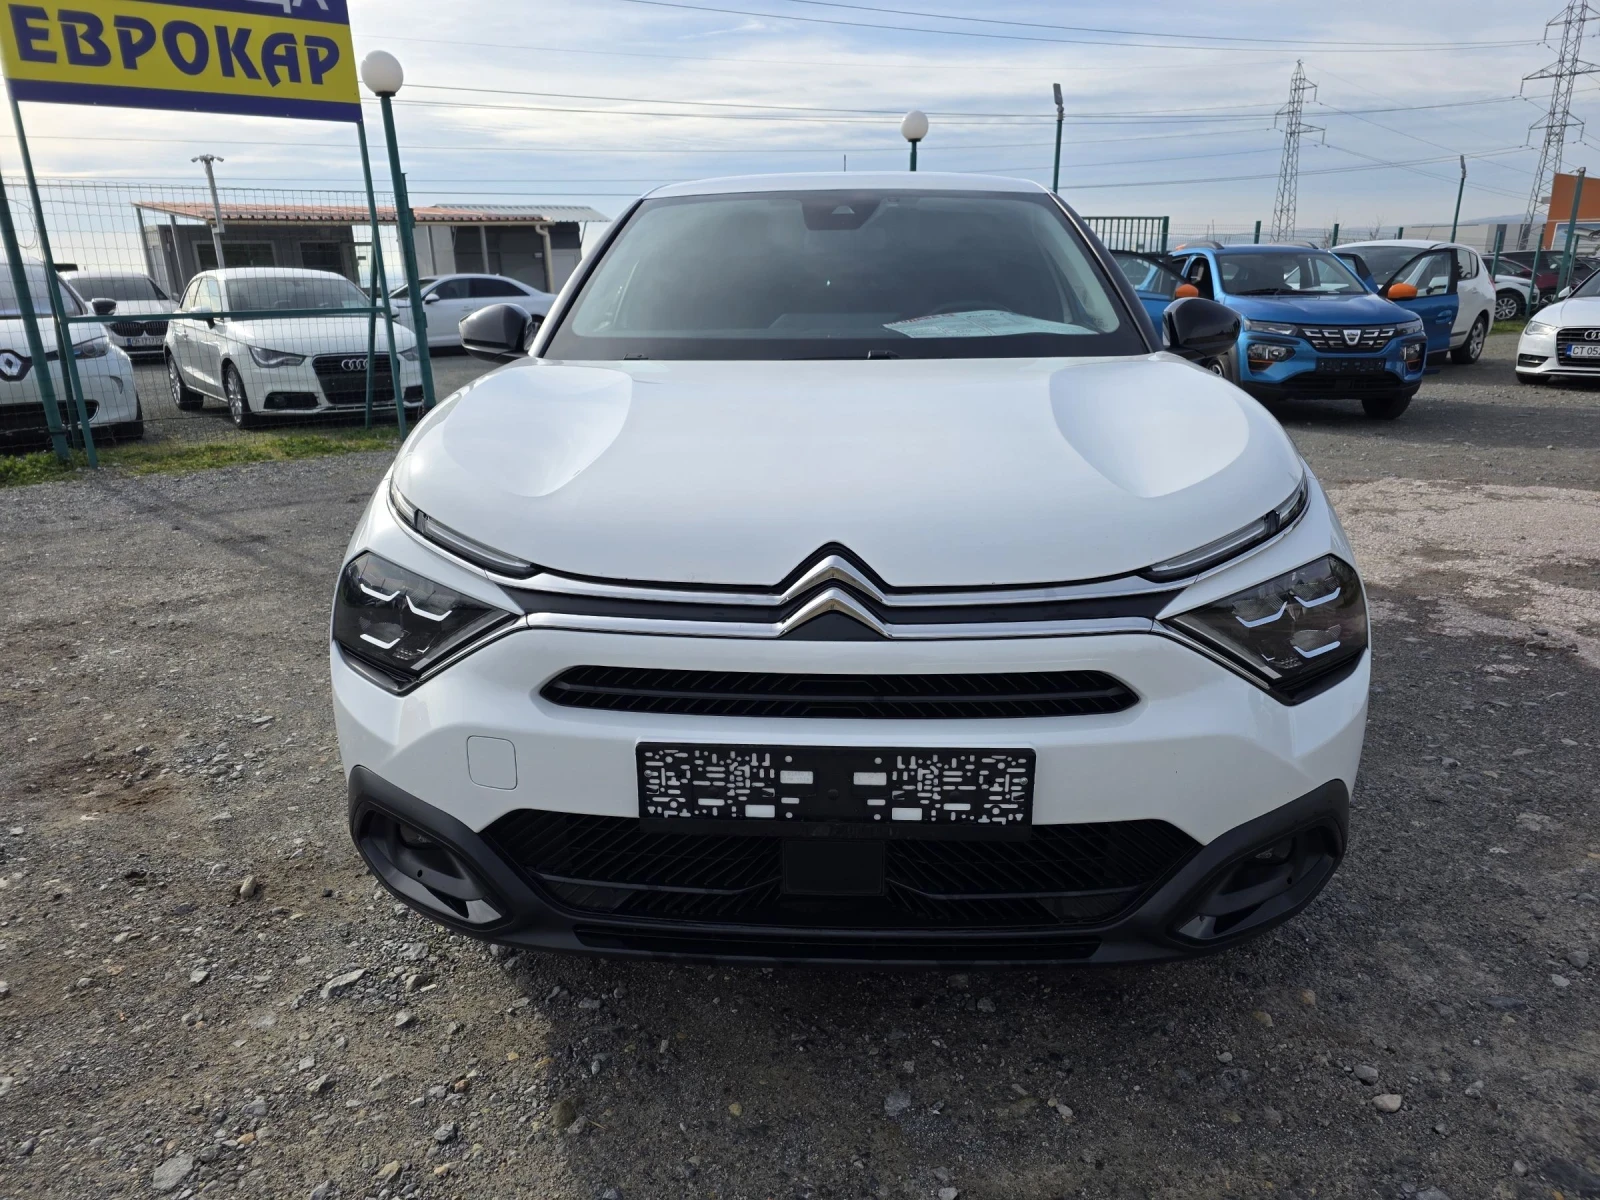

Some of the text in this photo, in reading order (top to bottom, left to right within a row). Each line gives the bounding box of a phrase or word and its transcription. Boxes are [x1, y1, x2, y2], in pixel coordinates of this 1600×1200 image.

[8, 3, 340, 87] ЕВРОКАР
[1573, 346, 1586, 355] CT
[1587, 346, 1600, 356] 05
